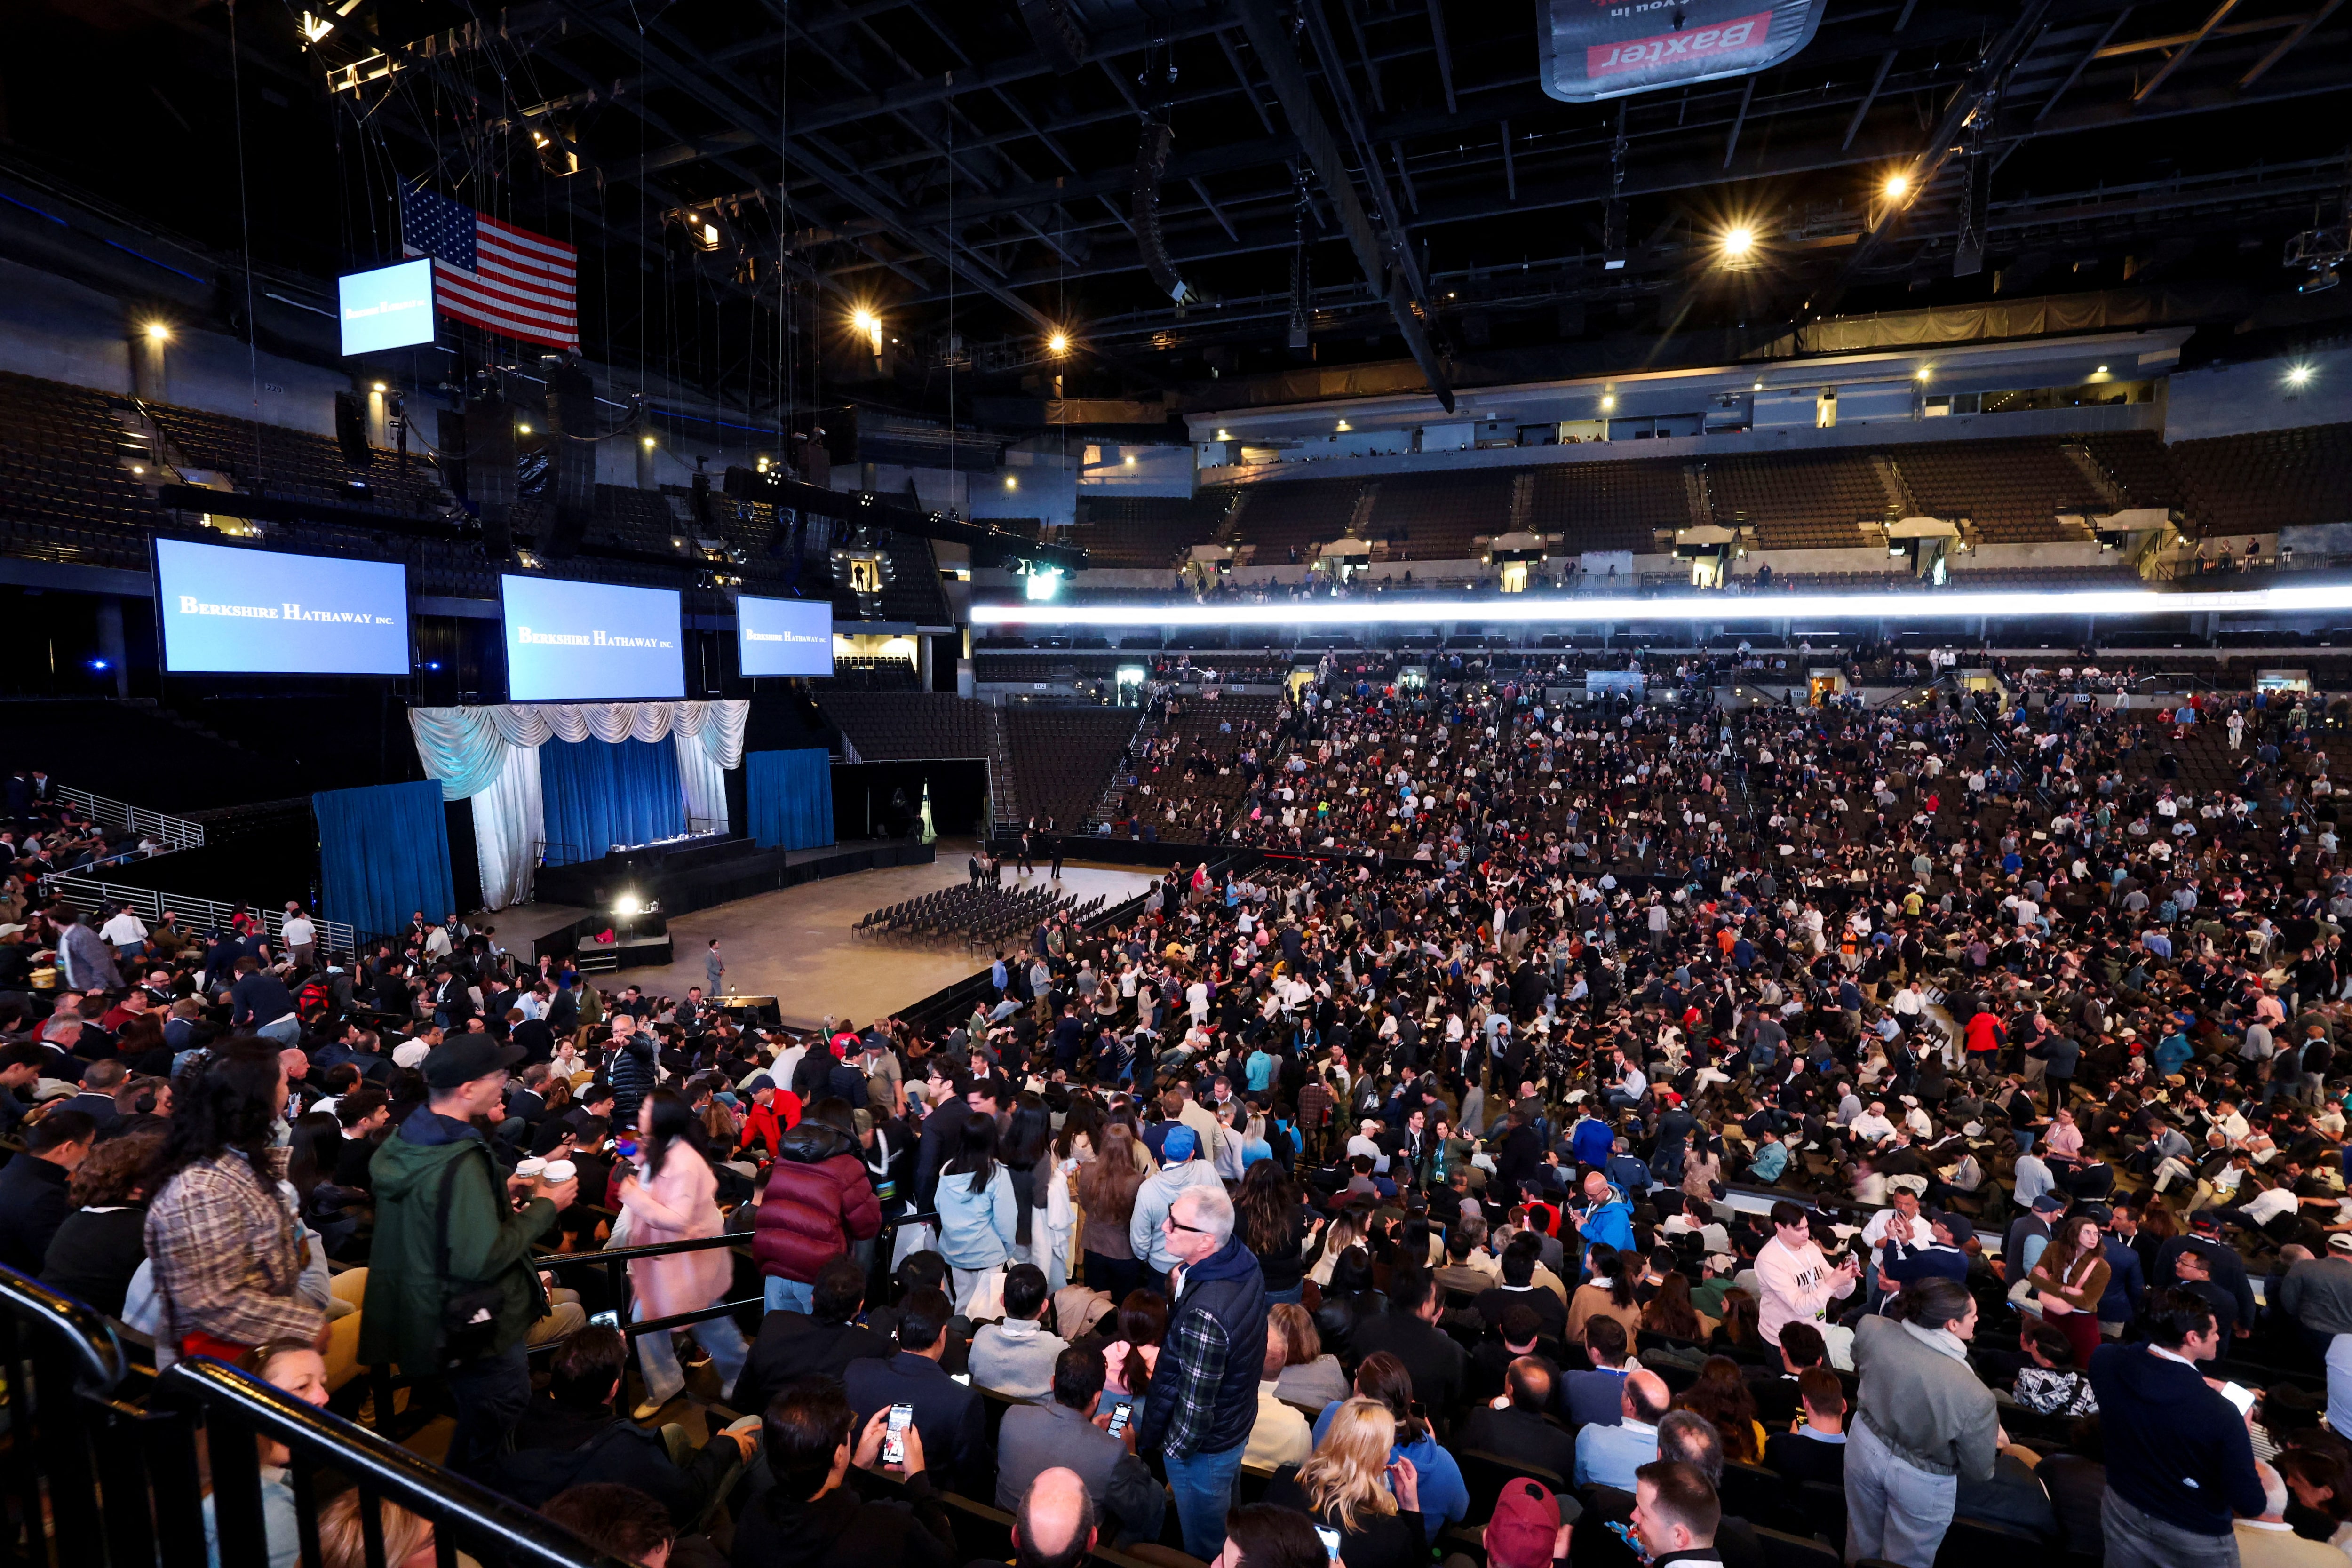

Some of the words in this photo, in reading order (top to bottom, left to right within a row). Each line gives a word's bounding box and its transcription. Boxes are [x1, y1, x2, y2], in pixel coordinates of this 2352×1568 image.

[1611, 7, 1630, 17] in
[1602, 21, 1755, 67] Baxter
[267, 384, 282, 393] 229
[179, 596, 278, 619] BERKSHIRE
[282, 604, 371, 624] HATHAWAY
[375, 616, 394, 625] INC.
[518, 626, 590, 645] BERKSHIRE
[593, 630, 658, 648] HATHAWAY
[746, 629, 783, 642] BERKSHIRE
[784, 631, 818, 643] HATHAWAY
